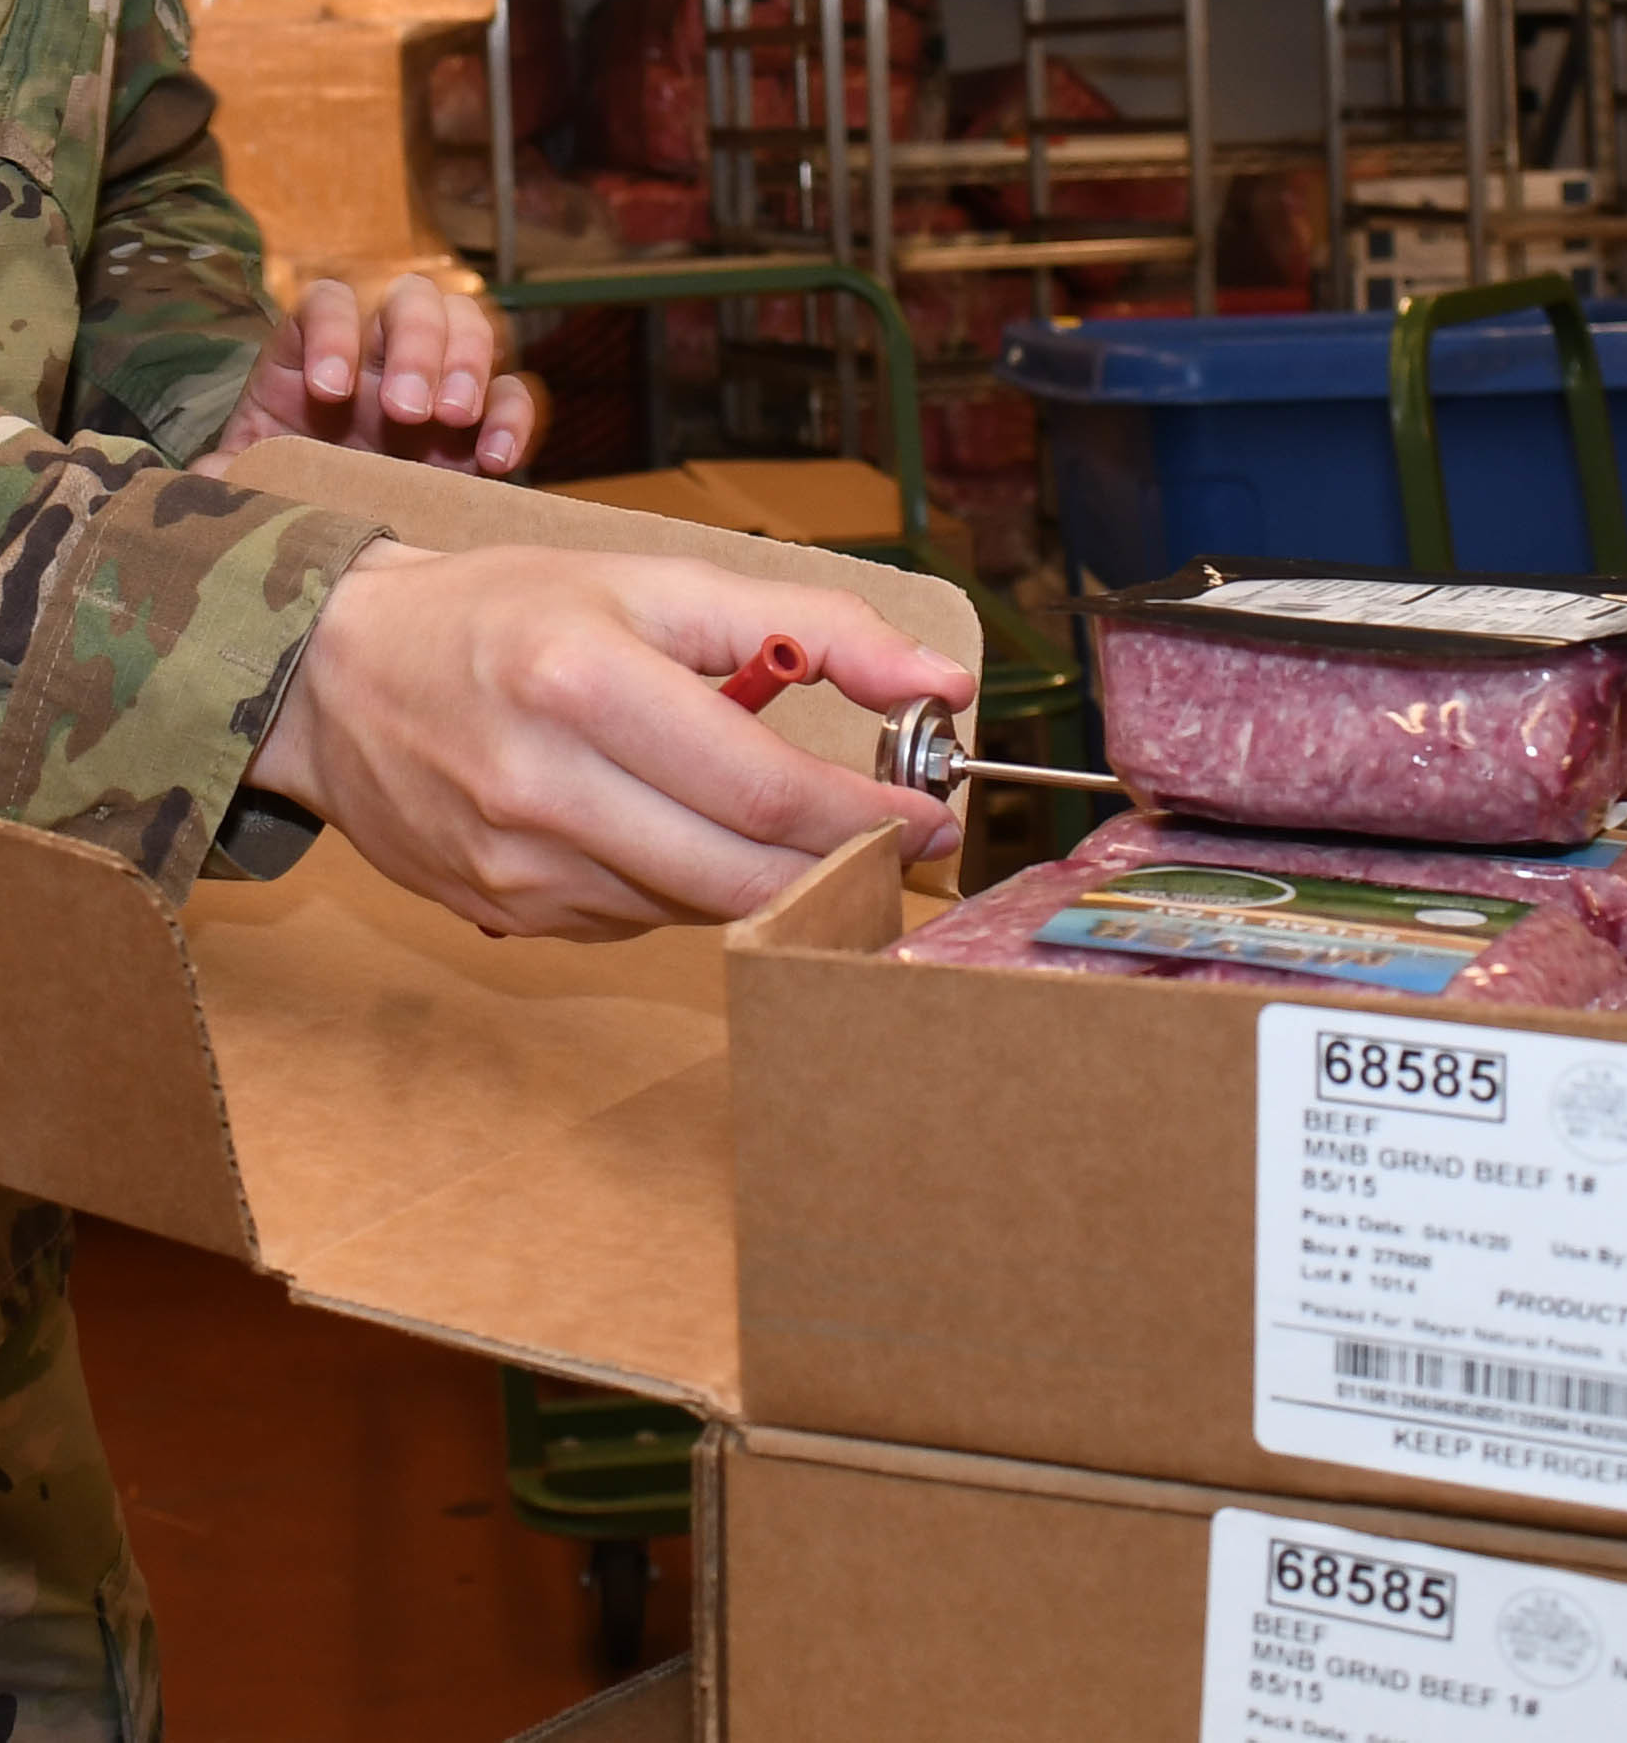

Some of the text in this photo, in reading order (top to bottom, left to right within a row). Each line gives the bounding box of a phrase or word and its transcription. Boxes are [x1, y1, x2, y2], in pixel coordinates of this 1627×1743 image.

[1086, 918, 1394, 970] MEYER
[1324, 1040, 1498, 1103] 68585
[1302, 1108, 1377, 1137] BEEF
[1302, 1138, 1369, 1168] MNB
[1377, 1147, 1465, 1181] GRND
[1474, 1159, 1551, 1192] BEEF
[1301, 1168, 1378, 1199] 85/15
[1301, 1206, 1349, 1228] Pack
[1300, 1236, 1339, 1257] Box
[1549, 1238, 1591, 1261] Use
[1299, 1264, 1333, 1281] Lot
[1391, 1426, 1474, 1458] KEEP
[1274, 1547, 1450, 1622] 68585
[1251, 1611, 1327, 1646] BEEF
[1248, 1669, 1324, 1705] 85/15
[1251, 1639, 1317, 1674] MNB
[1325, 1654, 1411, 1693] GRND
[1419, 1673, 1497, 1710] BEEF
[1246, 1706, 1295, 1732] Pack
